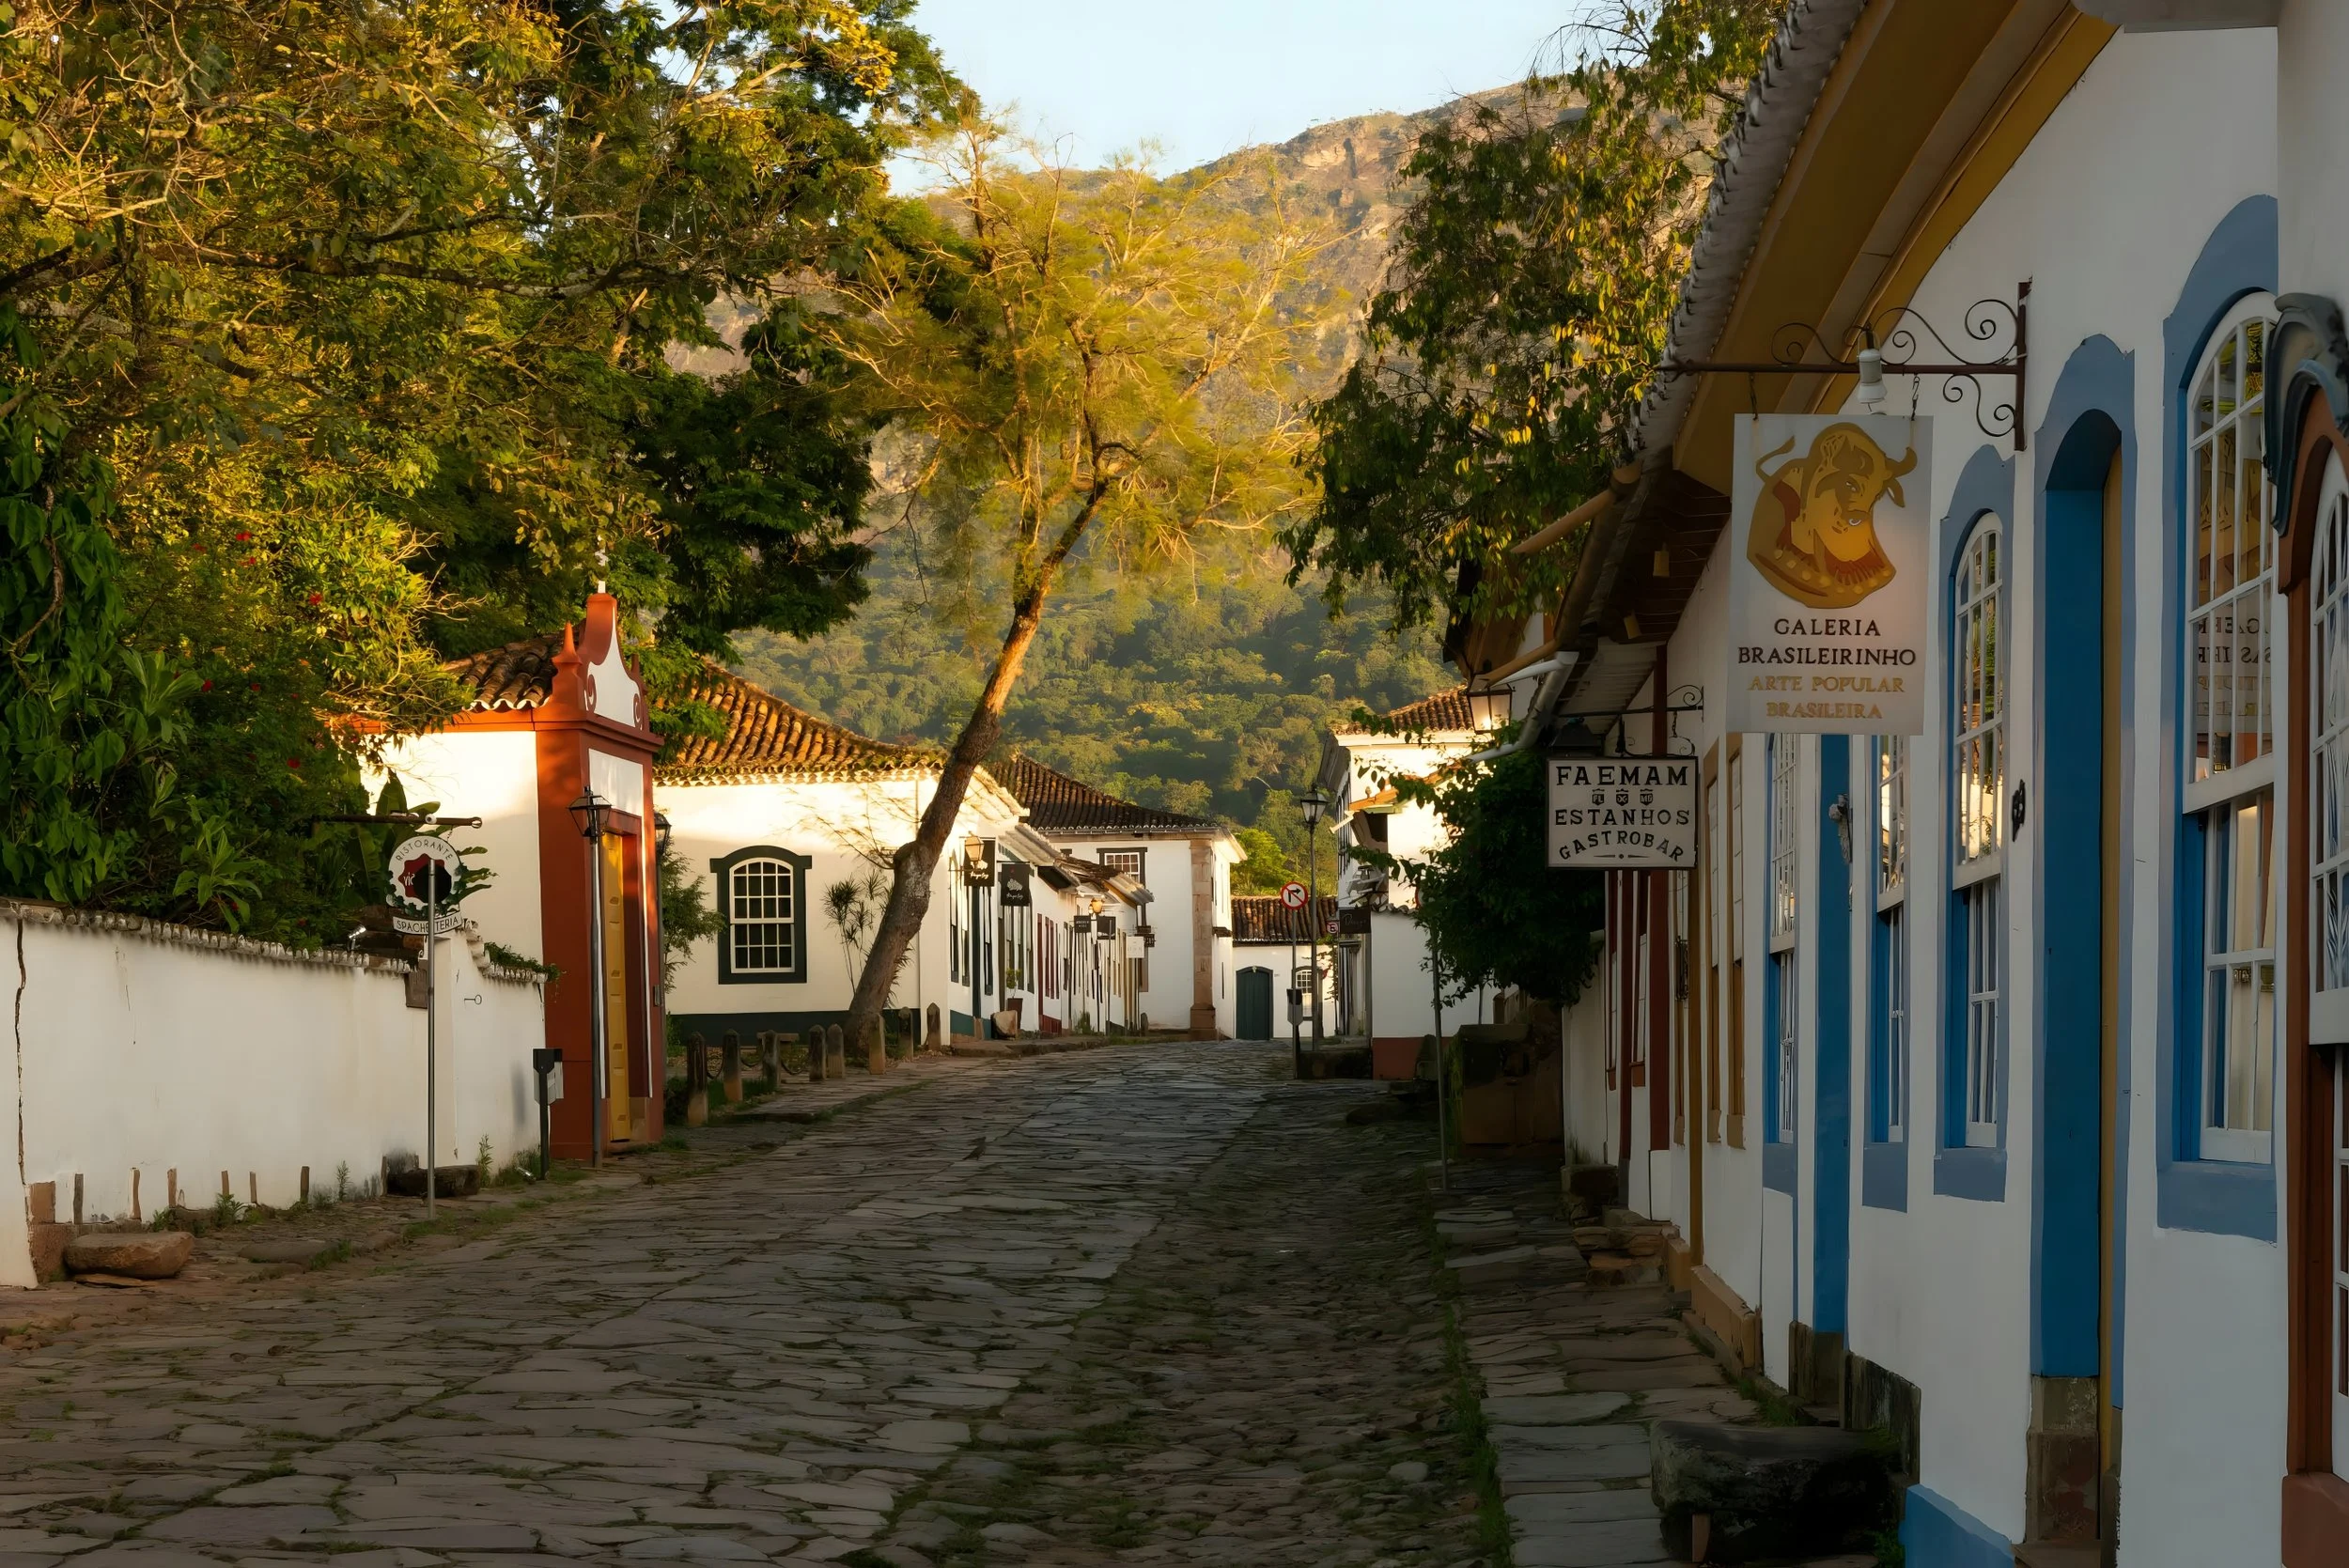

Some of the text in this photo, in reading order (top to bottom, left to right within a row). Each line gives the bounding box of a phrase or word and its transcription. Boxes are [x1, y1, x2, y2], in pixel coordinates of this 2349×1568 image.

[1774, 618, 1881, 636] GALERIA
[1737, 646, 1916, 666] BRASILEIRINHO
[1748, 675, 1905, 693] ARTE POPULAR
[1766, 702, 1883, 719] BRASILEIRA
[1556, 766, 1688, 786] FAEMAM
[1555, 809, 1690, 826] ESTANHOS
[396, 839, 454, 862] RISTORANTE
[1559, 830, 1684, 862] GASTROBAR
